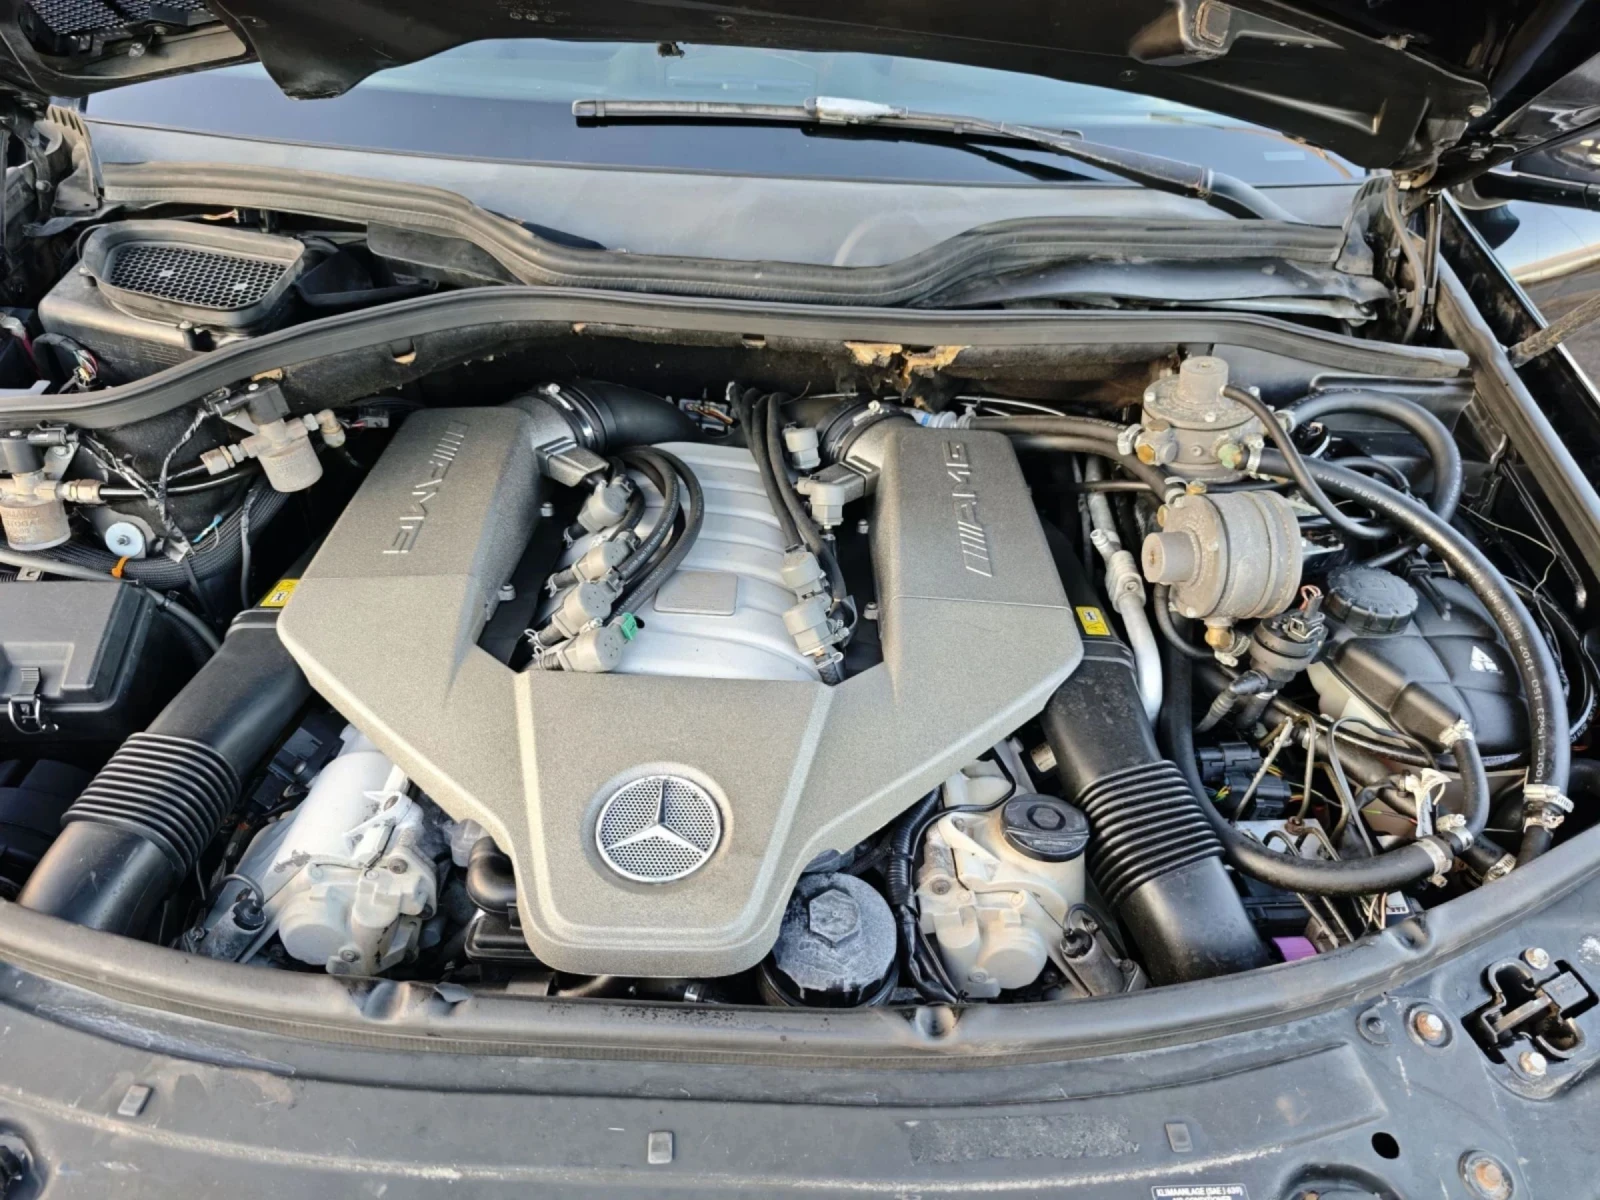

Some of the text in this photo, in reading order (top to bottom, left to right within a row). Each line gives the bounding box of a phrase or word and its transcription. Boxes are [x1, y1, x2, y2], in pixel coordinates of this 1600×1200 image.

[1487, 590, 1500, 603] NR
[1500, 608, 1522, 640] BATCH
[1519, 646, 1535, 671] 1307
[1532, 679, 1543, 700] ISO
[1537, 708, 1546, 740] 15x23
